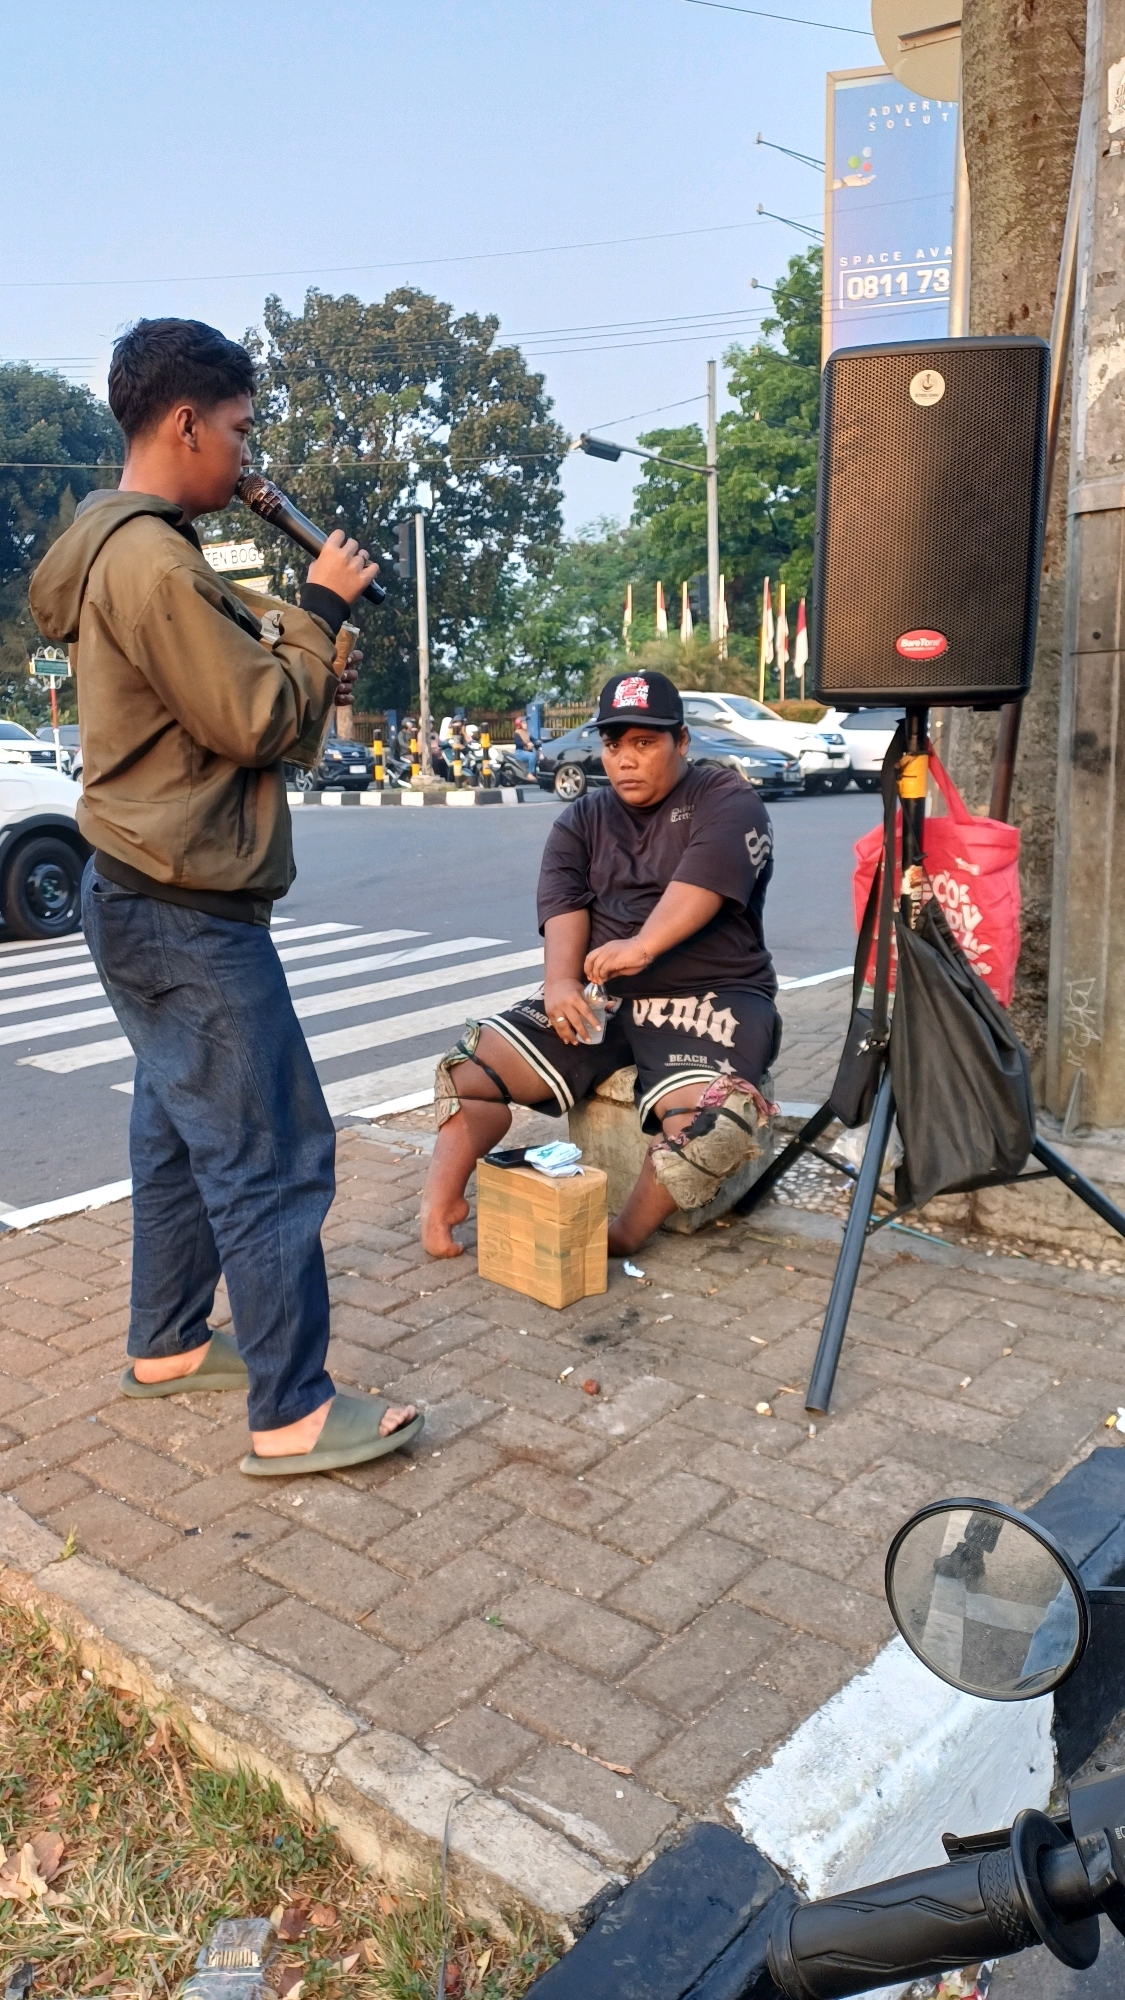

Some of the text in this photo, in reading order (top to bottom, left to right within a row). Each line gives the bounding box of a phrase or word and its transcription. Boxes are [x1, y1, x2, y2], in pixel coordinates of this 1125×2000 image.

[868, 100, 959, 118] ADVERTI
[868, 112, 949, 132] SOLUT
[839, 245, 953, 267] SPACE AVA
[846, 267, 950, 301] 0811 73
[669, 1053, 708, 1065] BEACH
